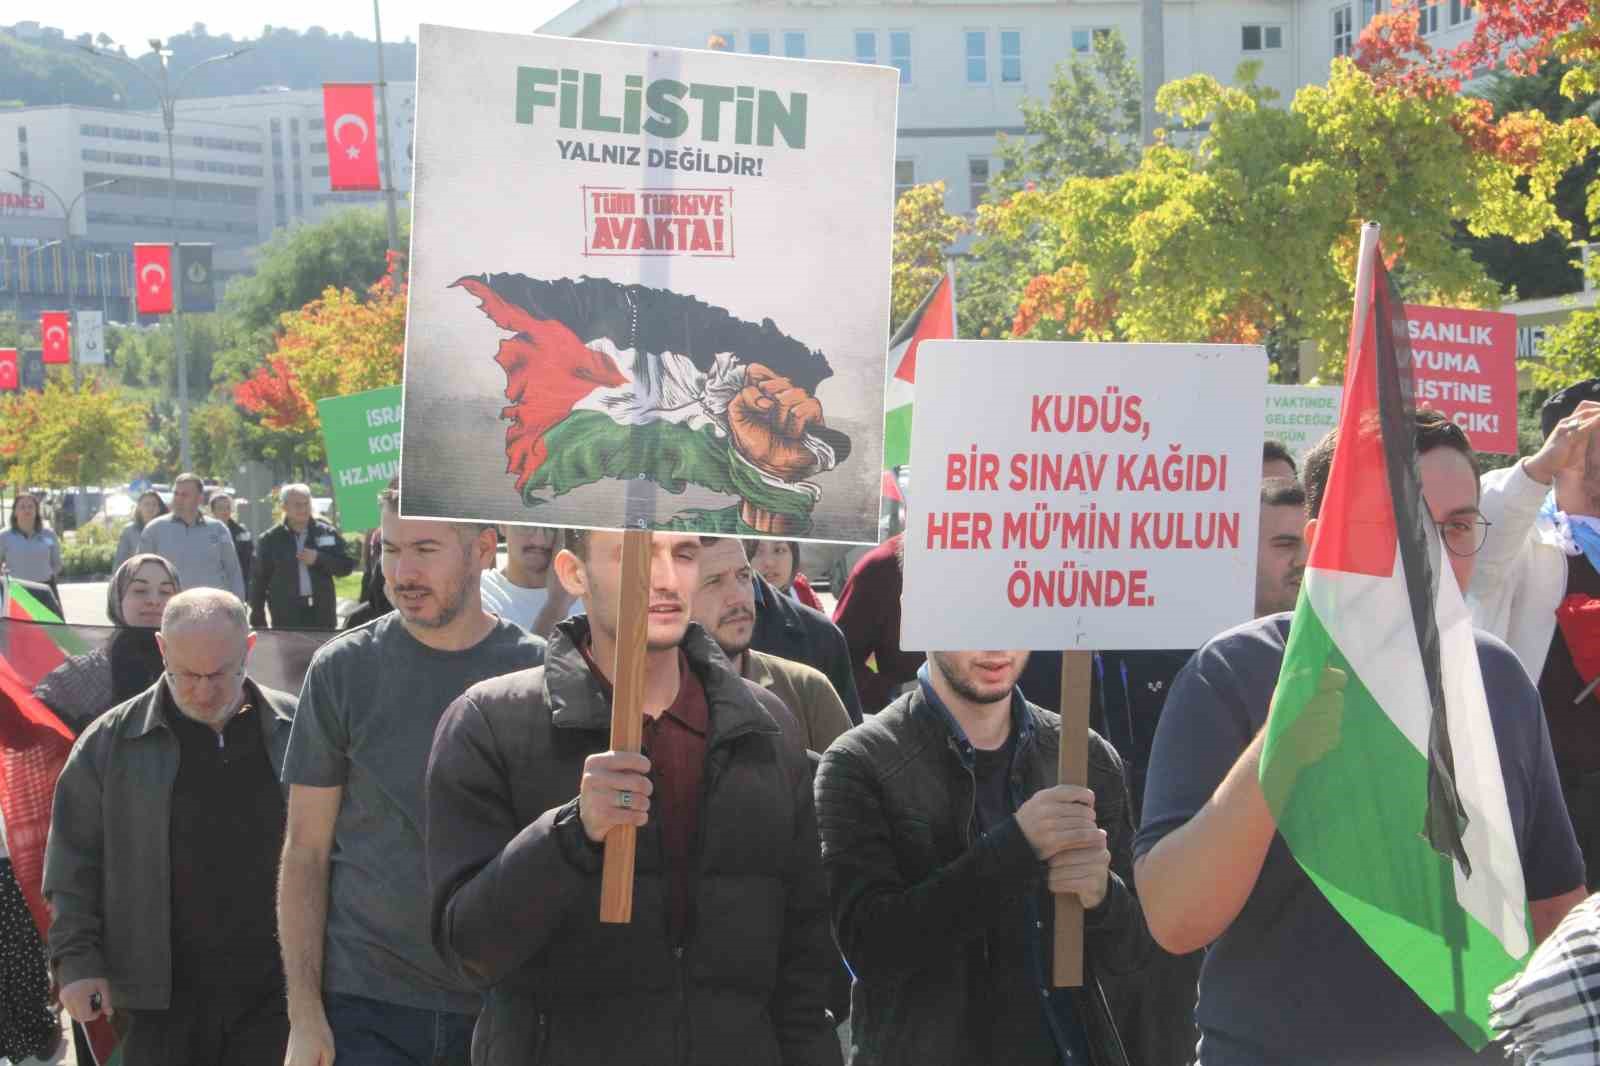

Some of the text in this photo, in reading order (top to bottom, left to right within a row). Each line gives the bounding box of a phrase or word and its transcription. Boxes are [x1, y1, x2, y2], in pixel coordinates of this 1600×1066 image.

[516, 66, 808, 149] FİLİSTİN
[557, 140, 763, 176] YALNIZ DEĞİLDİR!
[591, 192, 723, 216] TÜM TÜRKİYE
[592, 217, 724, 251] AYAKTA!
[1031, 386, 1150, 440] KUDÜS,
[945, 443, 1227, 492] BİR SINAV KAĞIDI
[926, 502, 1240, 550] HER MÜ'MİN KULUN
[1007, 561, 1155, 608] ÖNÜNDE.
